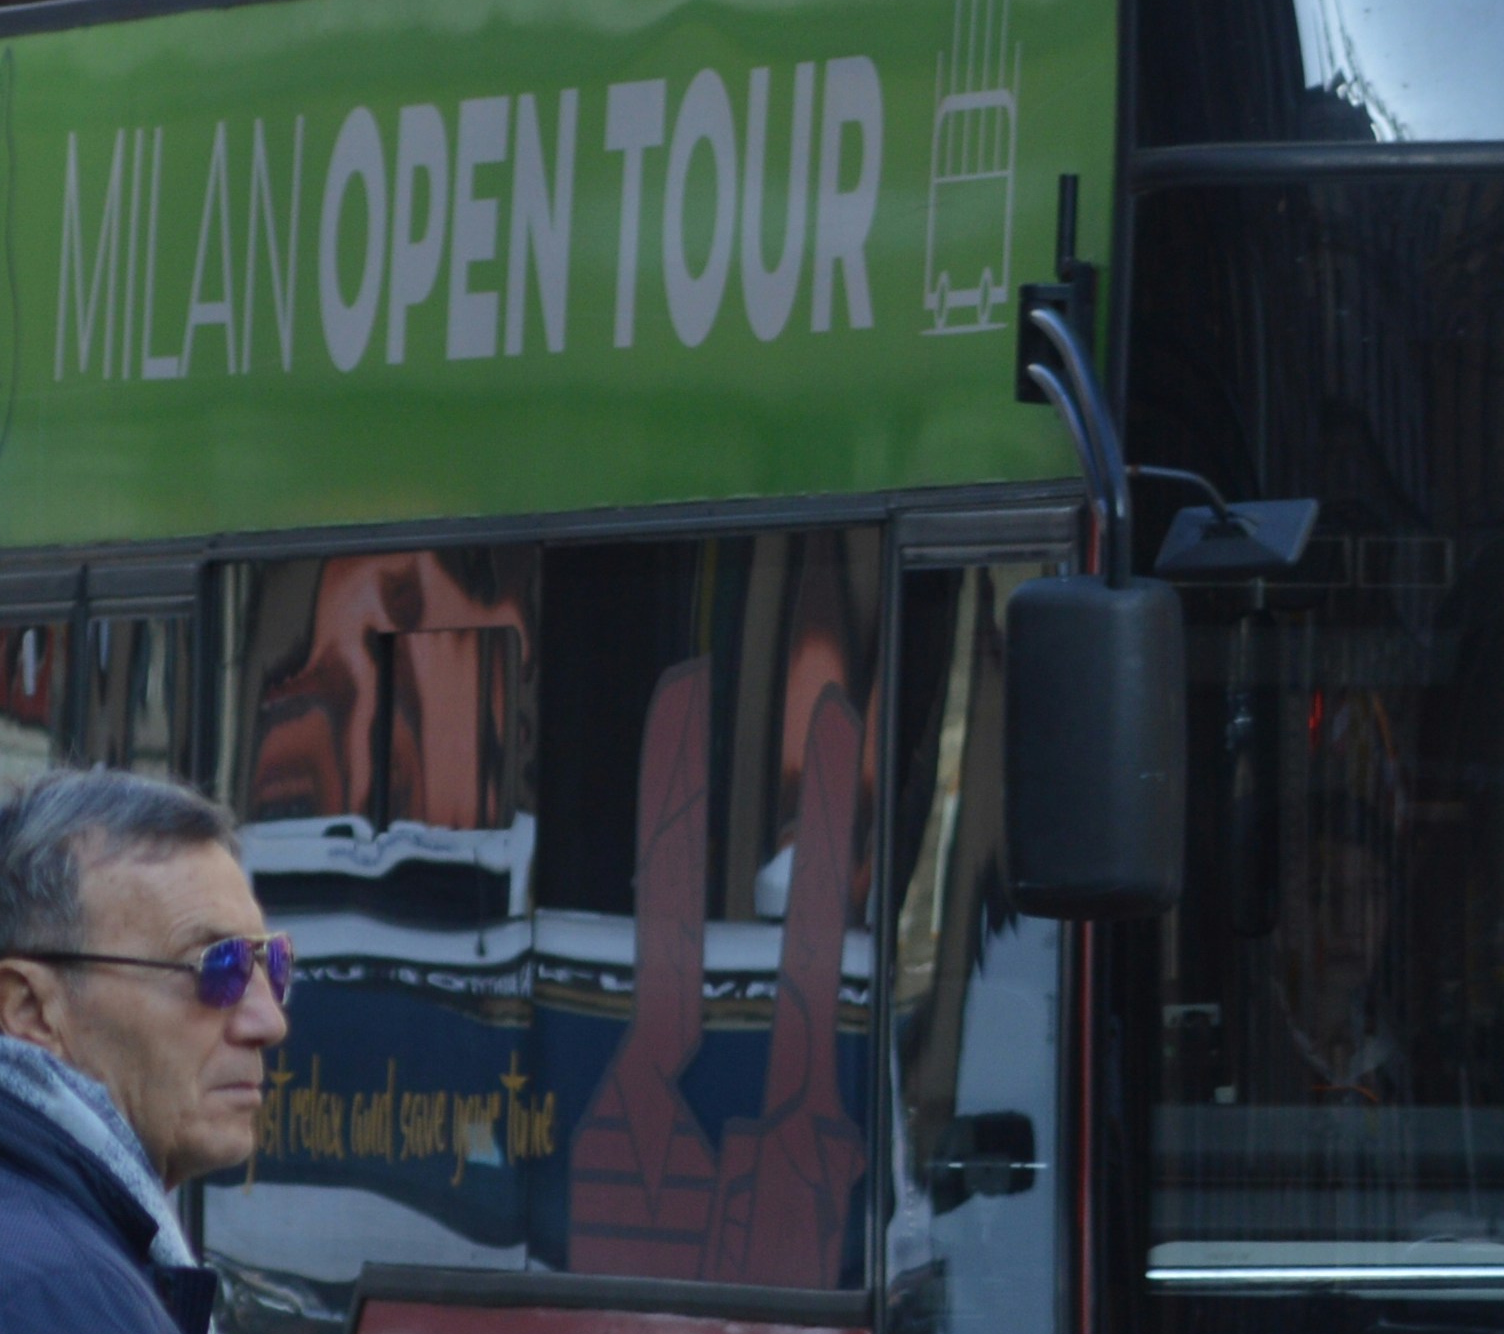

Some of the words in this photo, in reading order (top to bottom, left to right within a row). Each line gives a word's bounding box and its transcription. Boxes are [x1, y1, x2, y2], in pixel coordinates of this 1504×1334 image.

[53, 114, 303, 381] MILAN
[317, 88, 579, 373] OPEN
[604, 55, 884, 348] TOUR
[350, 1057, 395, 1165] and
[398, 1089, 447, 1161] save
